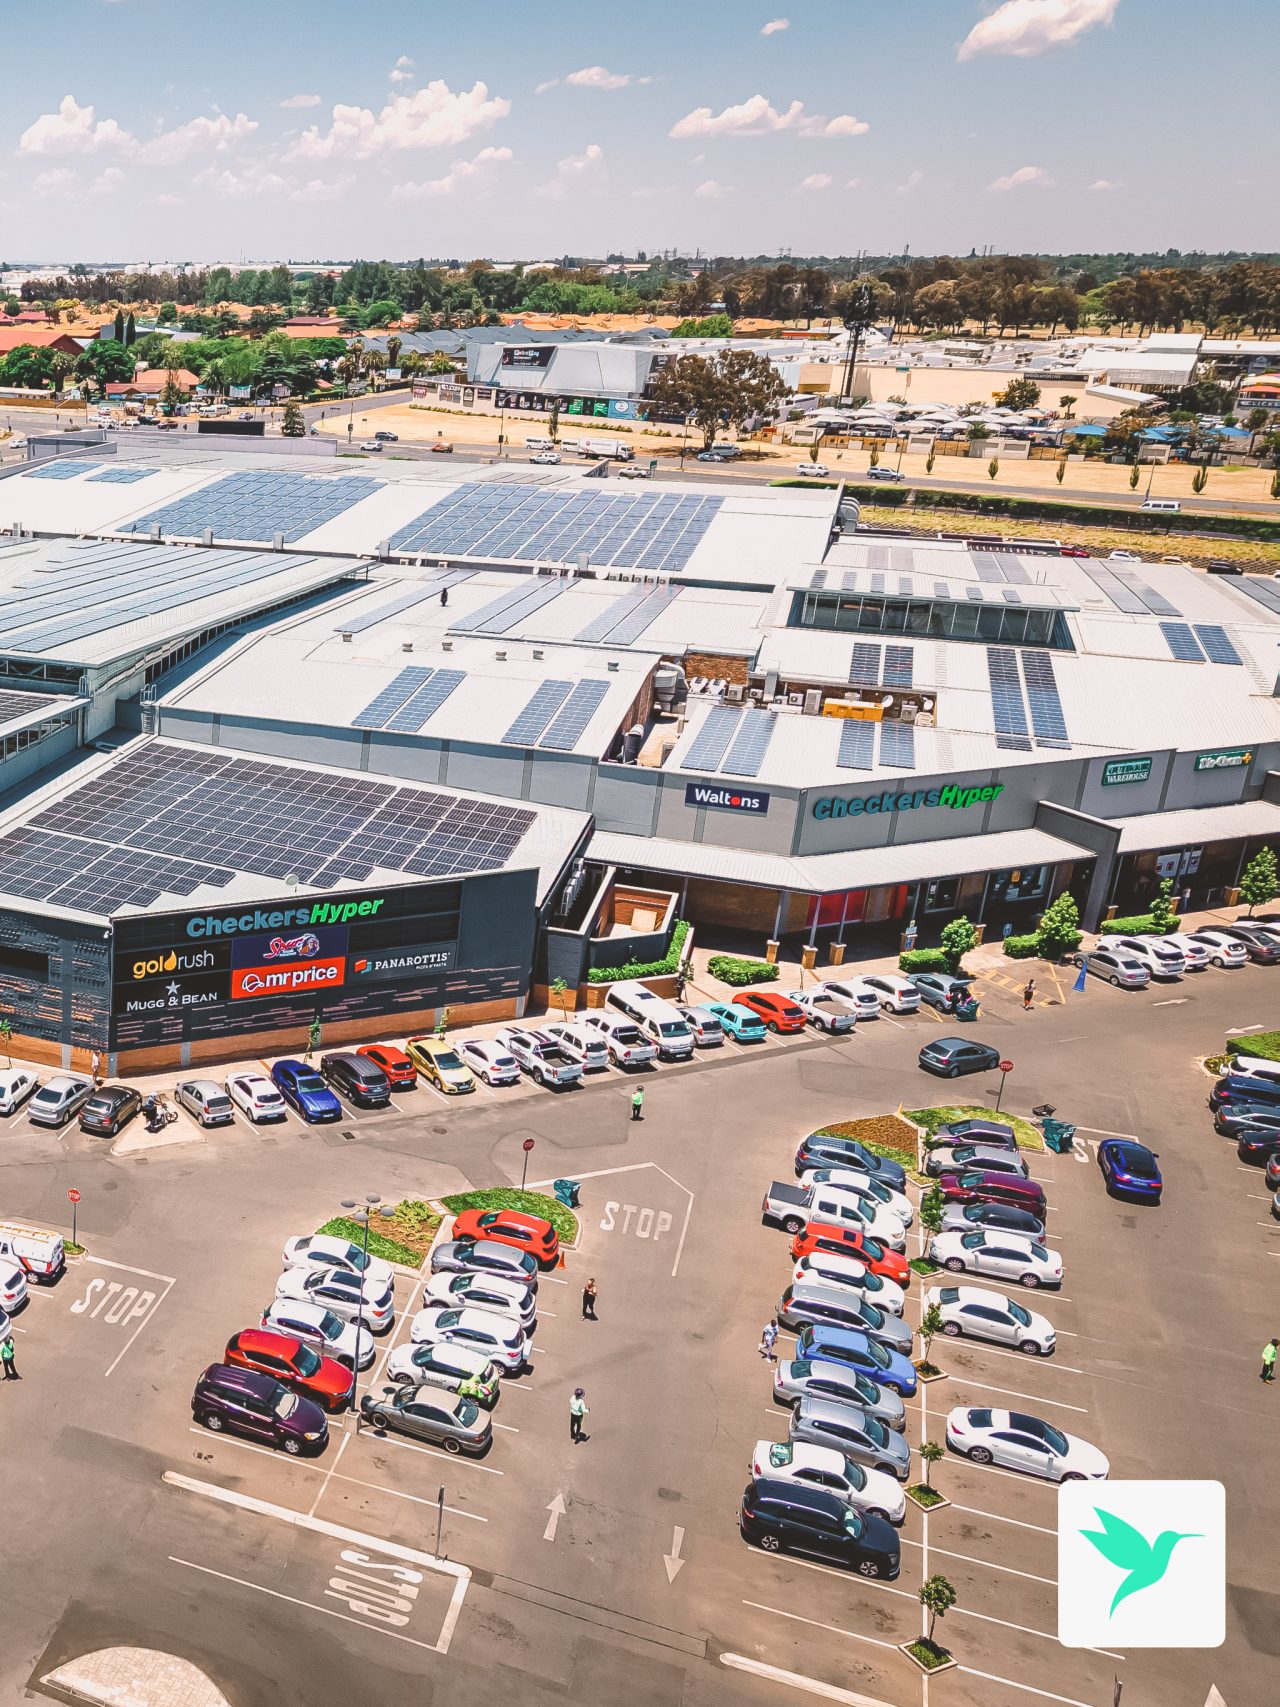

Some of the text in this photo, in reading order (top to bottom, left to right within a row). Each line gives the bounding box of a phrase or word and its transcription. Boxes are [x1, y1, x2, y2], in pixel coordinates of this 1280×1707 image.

[1107, 771, 1149, 783] WAREHOUSE
[694, 787, 760, 810] Waltons
[813, 784, 1004, 820] CheckersHyper
[186, 898, 385, 938] CheckersHyper
[263, 936, 304, 959] Spur
[126, 992, 218, 1013] MUGG & BEAN
[600, 1201, 672, 1241] STOP
[69, 1278, 156, 1326] STOP
[324, 1549, 424, 1627] STOP
